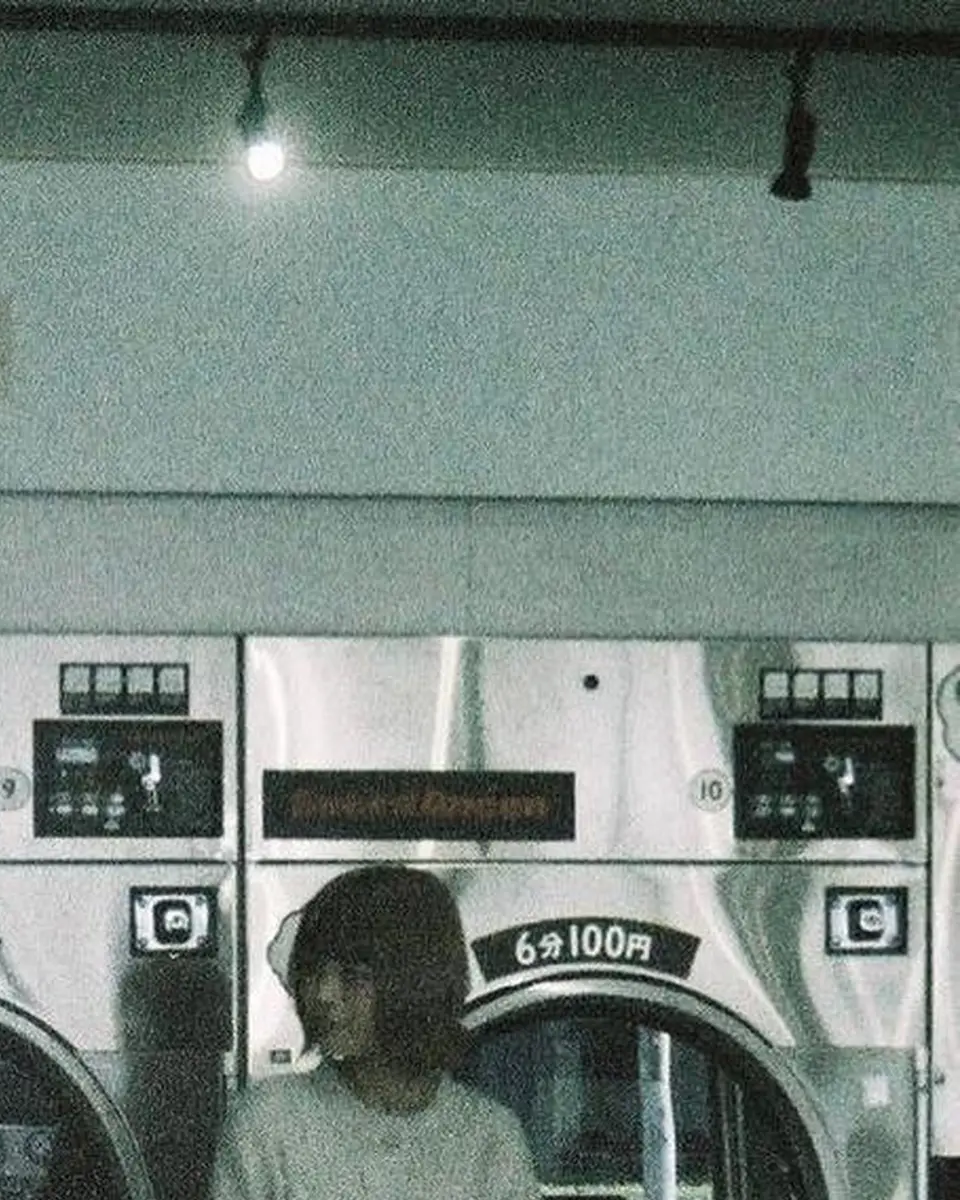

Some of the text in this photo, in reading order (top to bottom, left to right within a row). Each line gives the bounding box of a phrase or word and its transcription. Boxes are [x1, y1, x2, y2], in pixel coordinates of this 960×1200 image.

[2, 778, 16, 799] 9
[701, 780, 722, 801] 10
[515, 924, 652, 966] 6分100円
